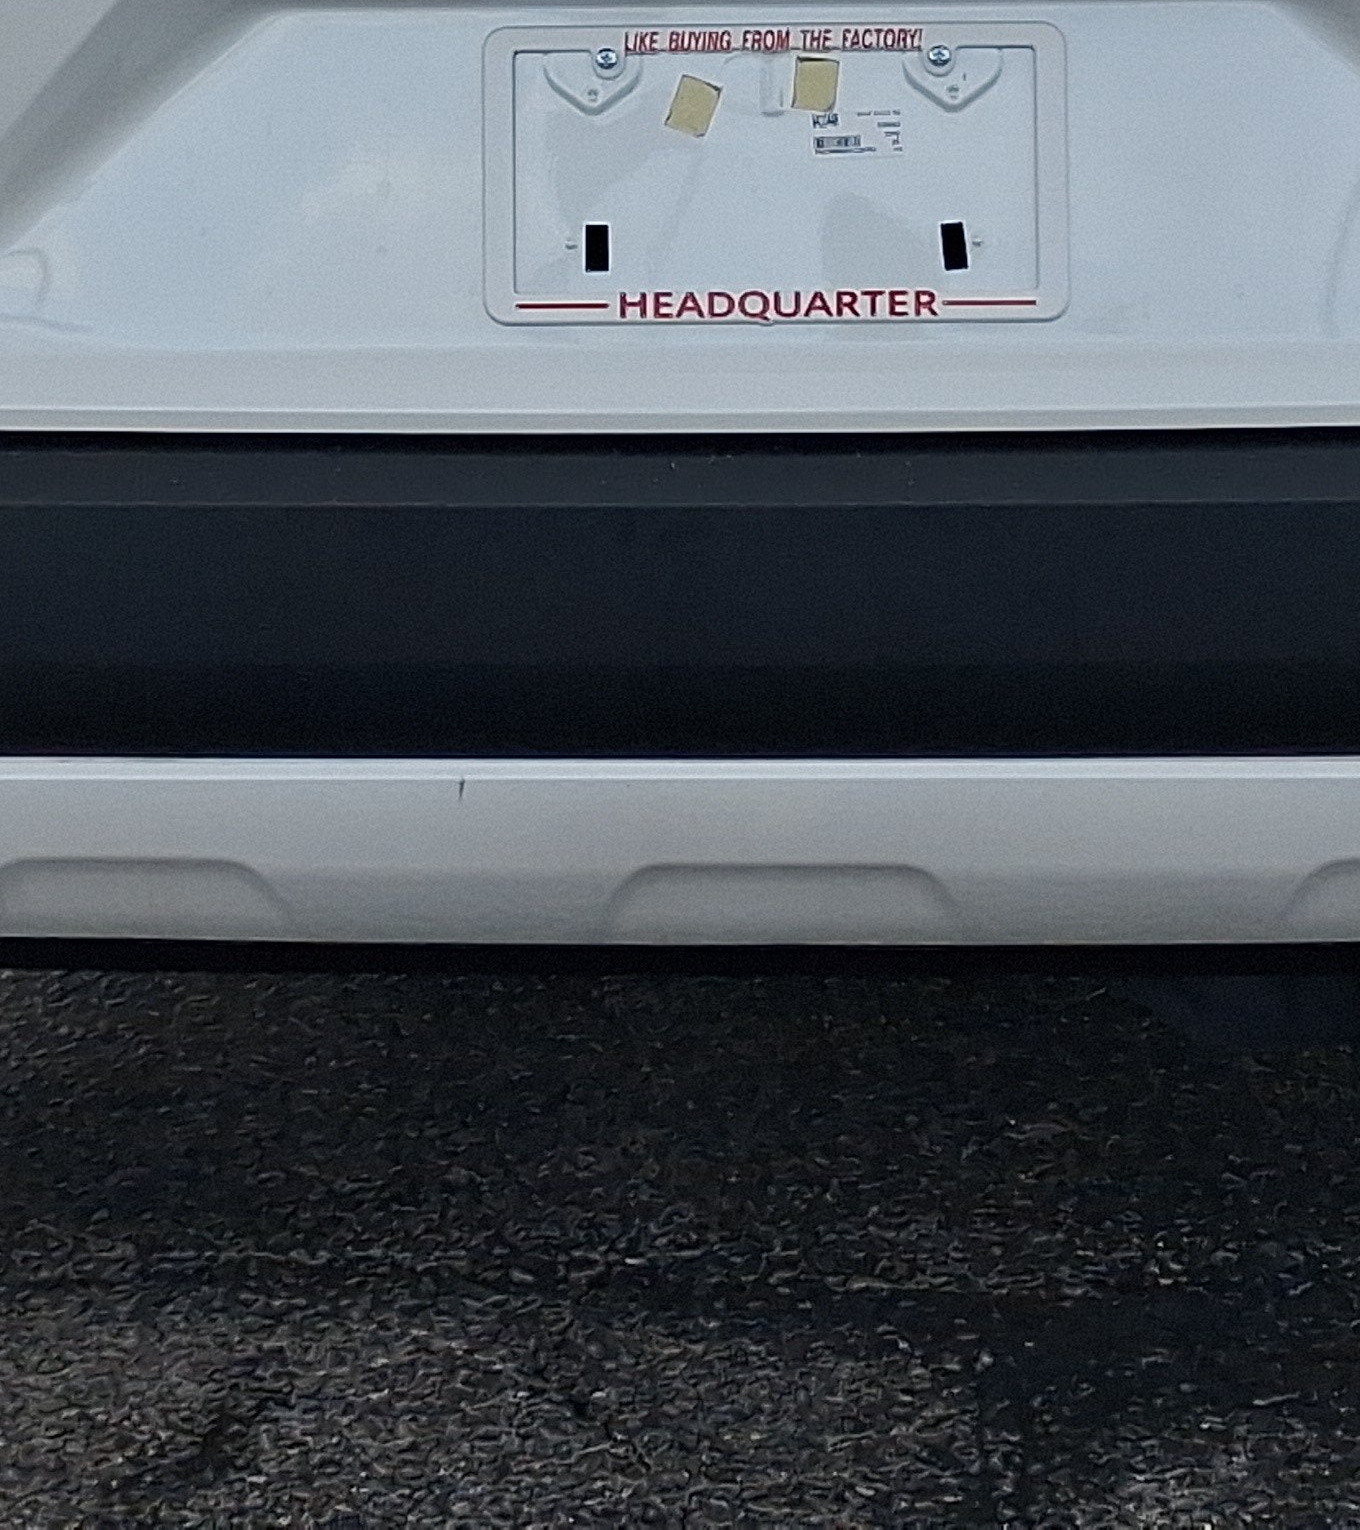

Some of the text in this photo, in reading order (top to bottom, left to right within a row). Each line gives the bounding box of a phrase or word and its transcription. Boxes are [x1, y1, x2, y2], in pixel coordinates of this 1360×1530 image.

[624, 27, 923, 53] LIKE BUYING FROM THE FACTORY!
[618, 289, 939, 321] HEADQUARTER
